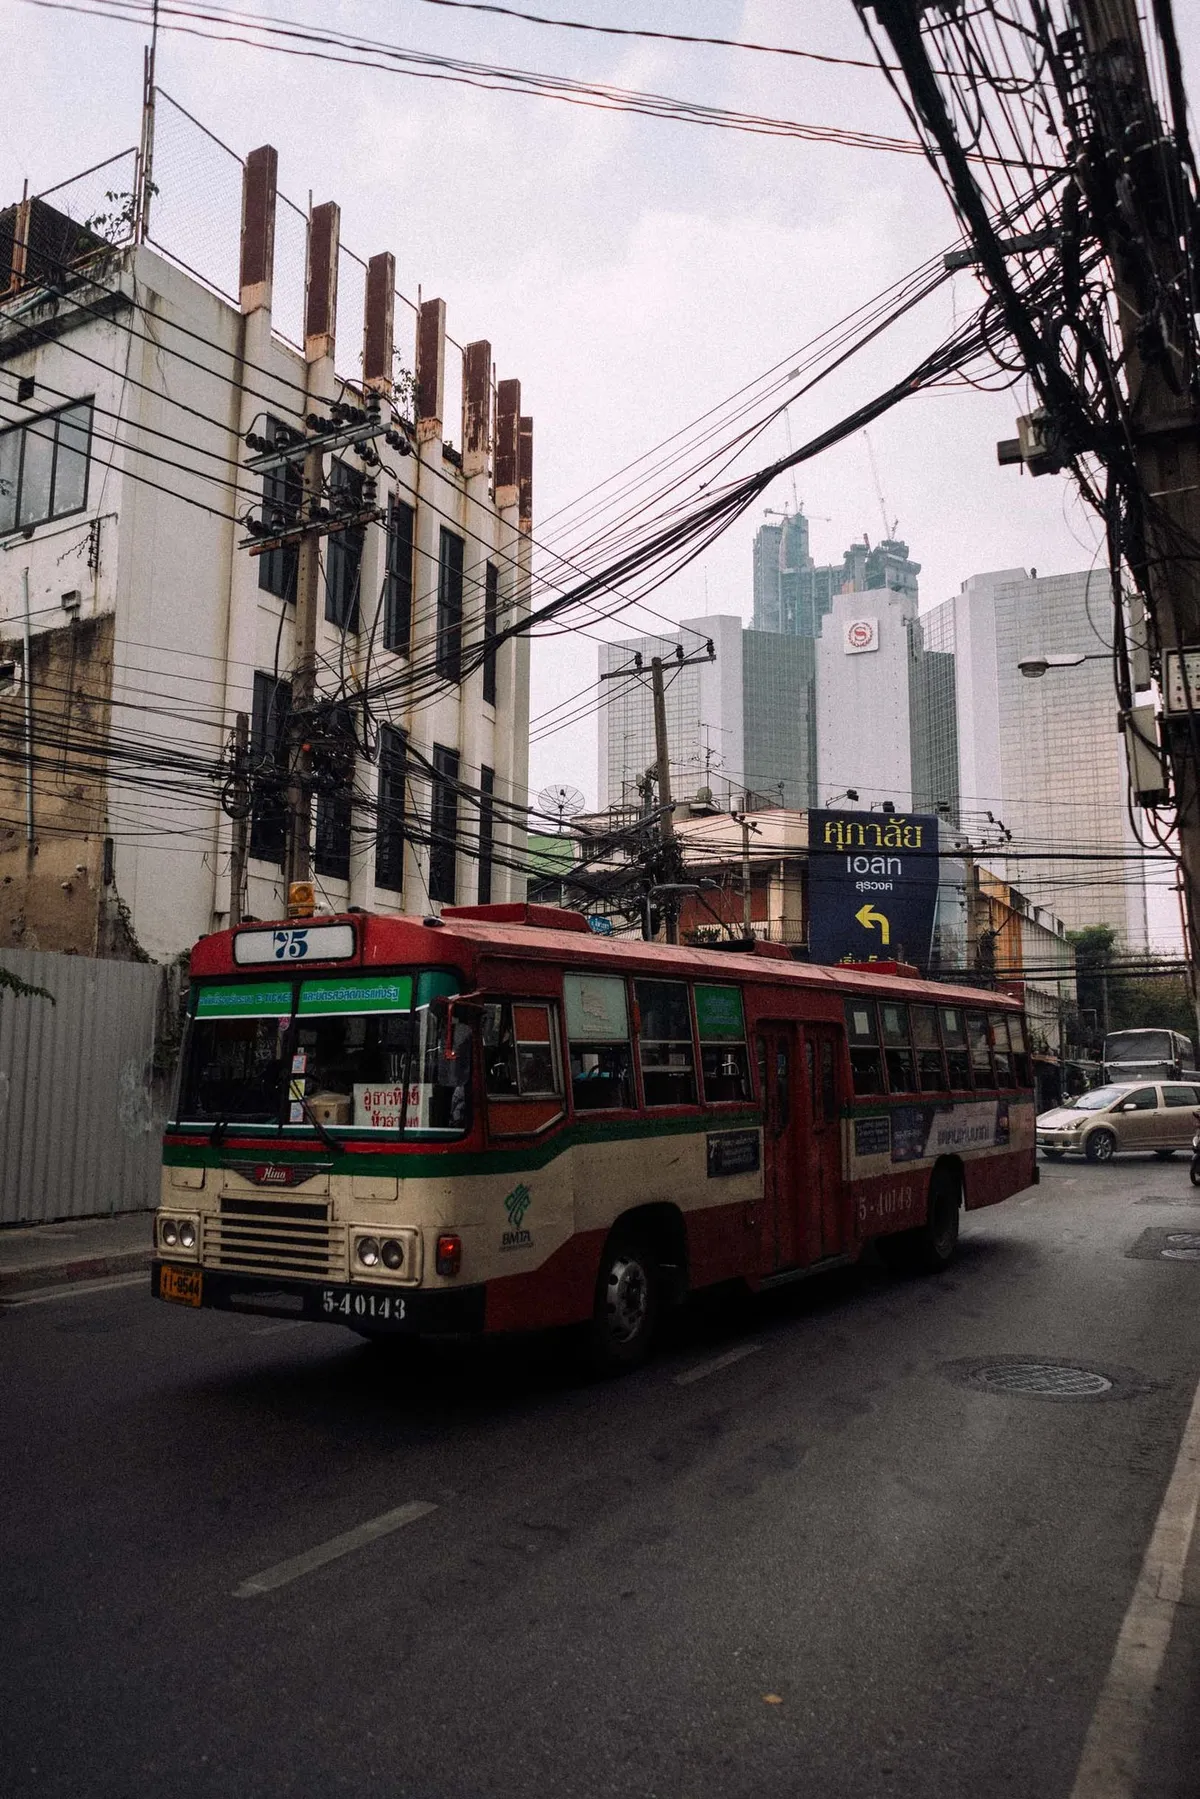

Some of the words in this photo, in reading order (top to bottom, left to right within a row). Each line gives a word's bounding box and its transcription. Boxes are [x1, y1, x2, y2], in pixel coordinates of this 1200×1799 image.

[823, 817, 923, 851] ศุภาลัย
[847, 855, 902, 875] เอลท
[273, 930, 308, 958] 75
[503, 1231, 531, 1245] BMTA
[322, 1290, 406, 1320] 5-40143
